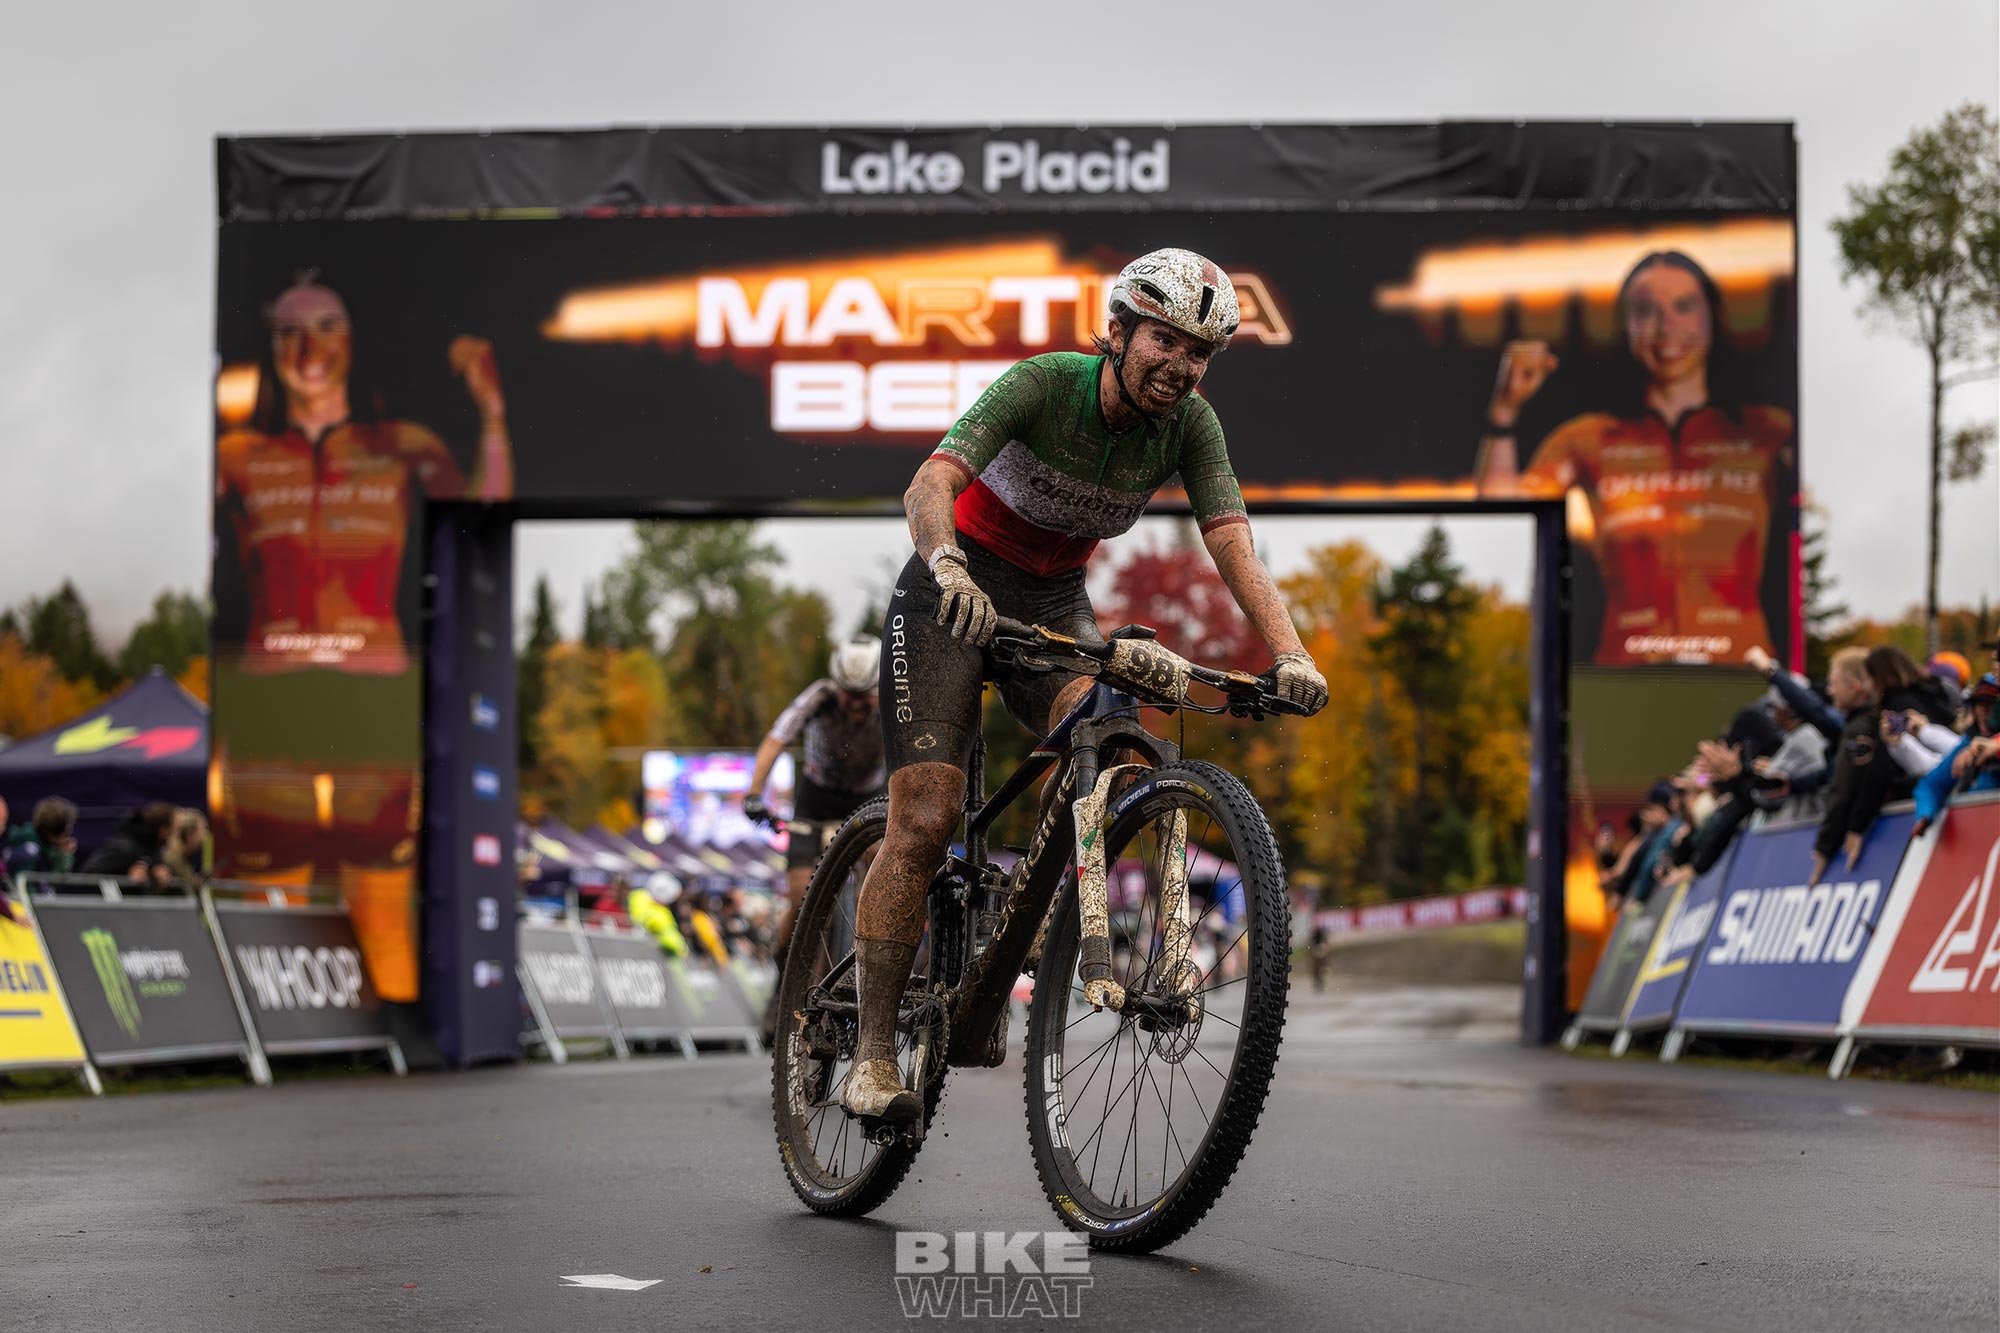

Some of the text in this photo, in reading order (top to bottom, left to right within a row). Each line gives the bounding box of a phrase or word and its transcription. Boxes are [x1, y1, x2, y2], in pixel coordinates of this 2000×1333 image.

[822, 138, 1170, 194] Lake Placid
[696, 275, 1293, 348] MARTIA
[1127, 646, 1175, 689] 98
[1706, 880, 1882, 966] SHIMANO
[236, 944, 363, 1010] WHOOP
